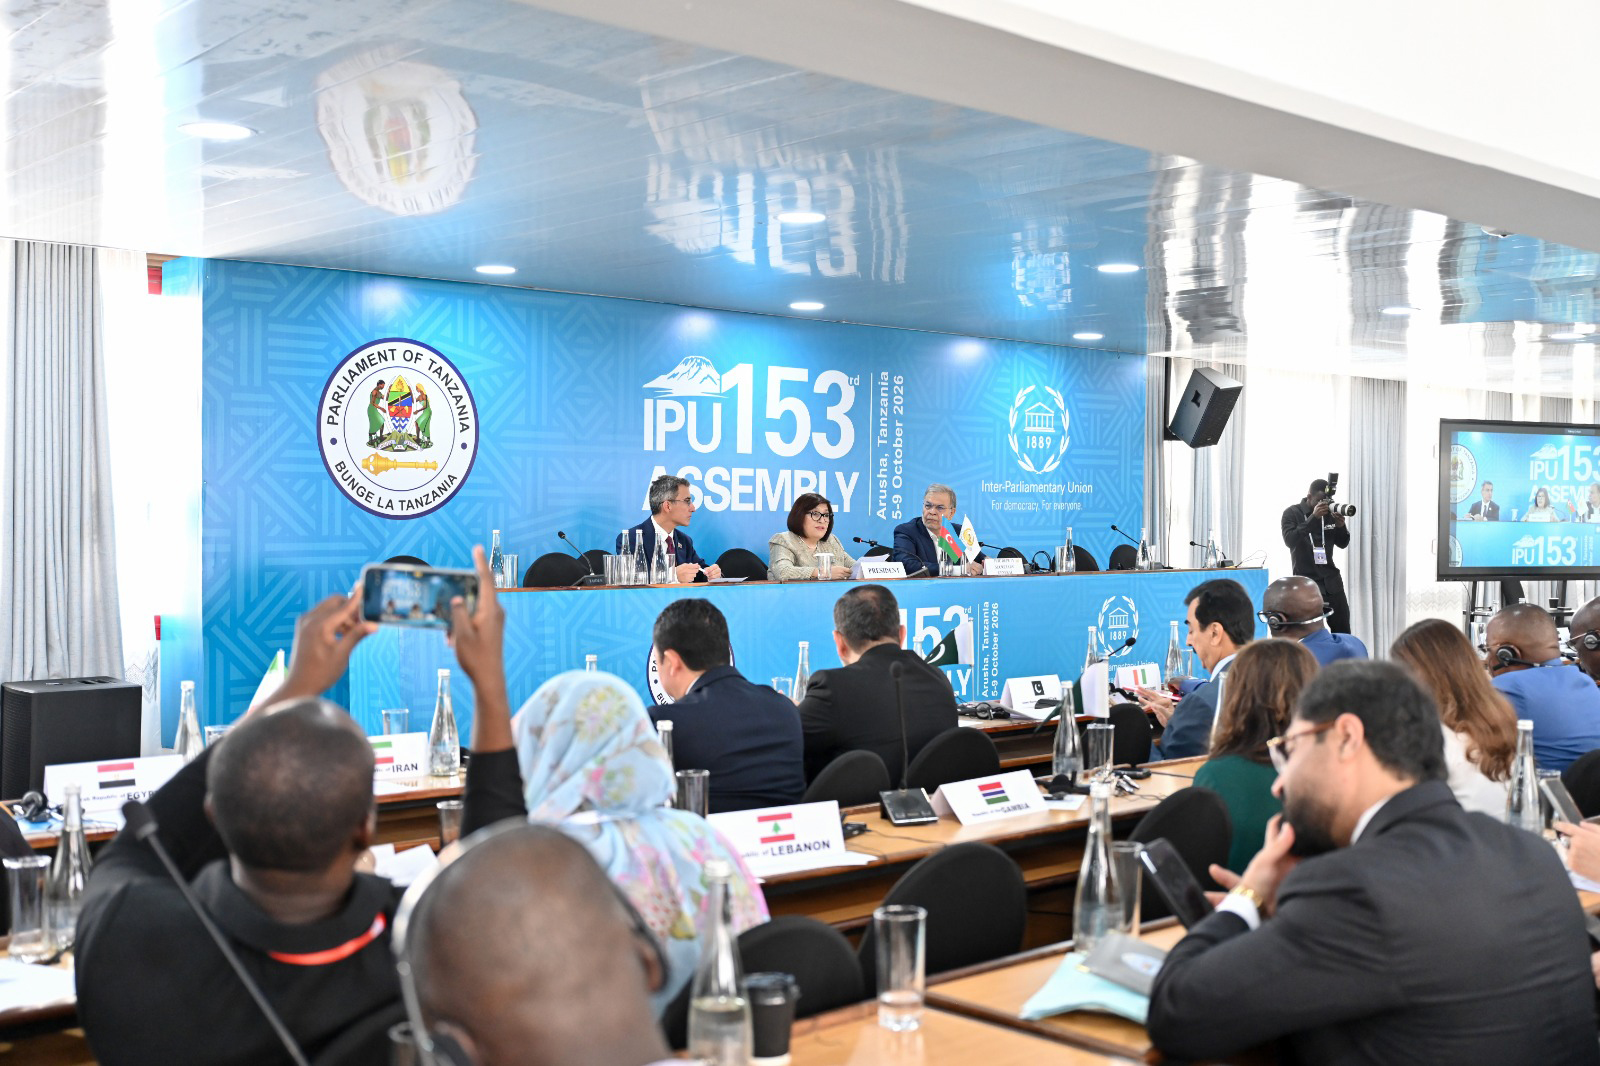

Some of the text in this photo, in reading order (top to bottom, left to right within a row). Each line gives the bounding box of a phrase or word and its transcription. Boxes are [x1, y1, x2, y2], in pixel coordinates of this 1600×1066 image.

[326, 348, 470, 433] PARLIAMENT OF TANZANIA
[643, 398, 722, 454] IPU
[876, 371, 890, 520] Arusha, Tanzania
[891, 375, 904, 520] 5-9 October 2026
[1026, 435, 1052, 449] 1889
[1529, 459, 1559, 481] IPU
[334, 460, 458, 511] BUNGE LA TANZANIA
[981, 479, 1093, 496] Inter-Parliamentary Union
[991, 499, 1003, 511] For
[1041, 499, 1053, 511] For
[1511, 547, 1535, 565] IPU
[1109, 631, 1127, 641] 1889
[981, 601, 990, 698] Arusha, Tanzania
[991, 602, 999, 697] 5-9 October 2026
[392, 763, 418, 773] IRAN
[127, 790, 156, 801] EGYP
[1000, 803, 1031, 814] GAMBIA
[770, 840, 831, 857] LEBANON
